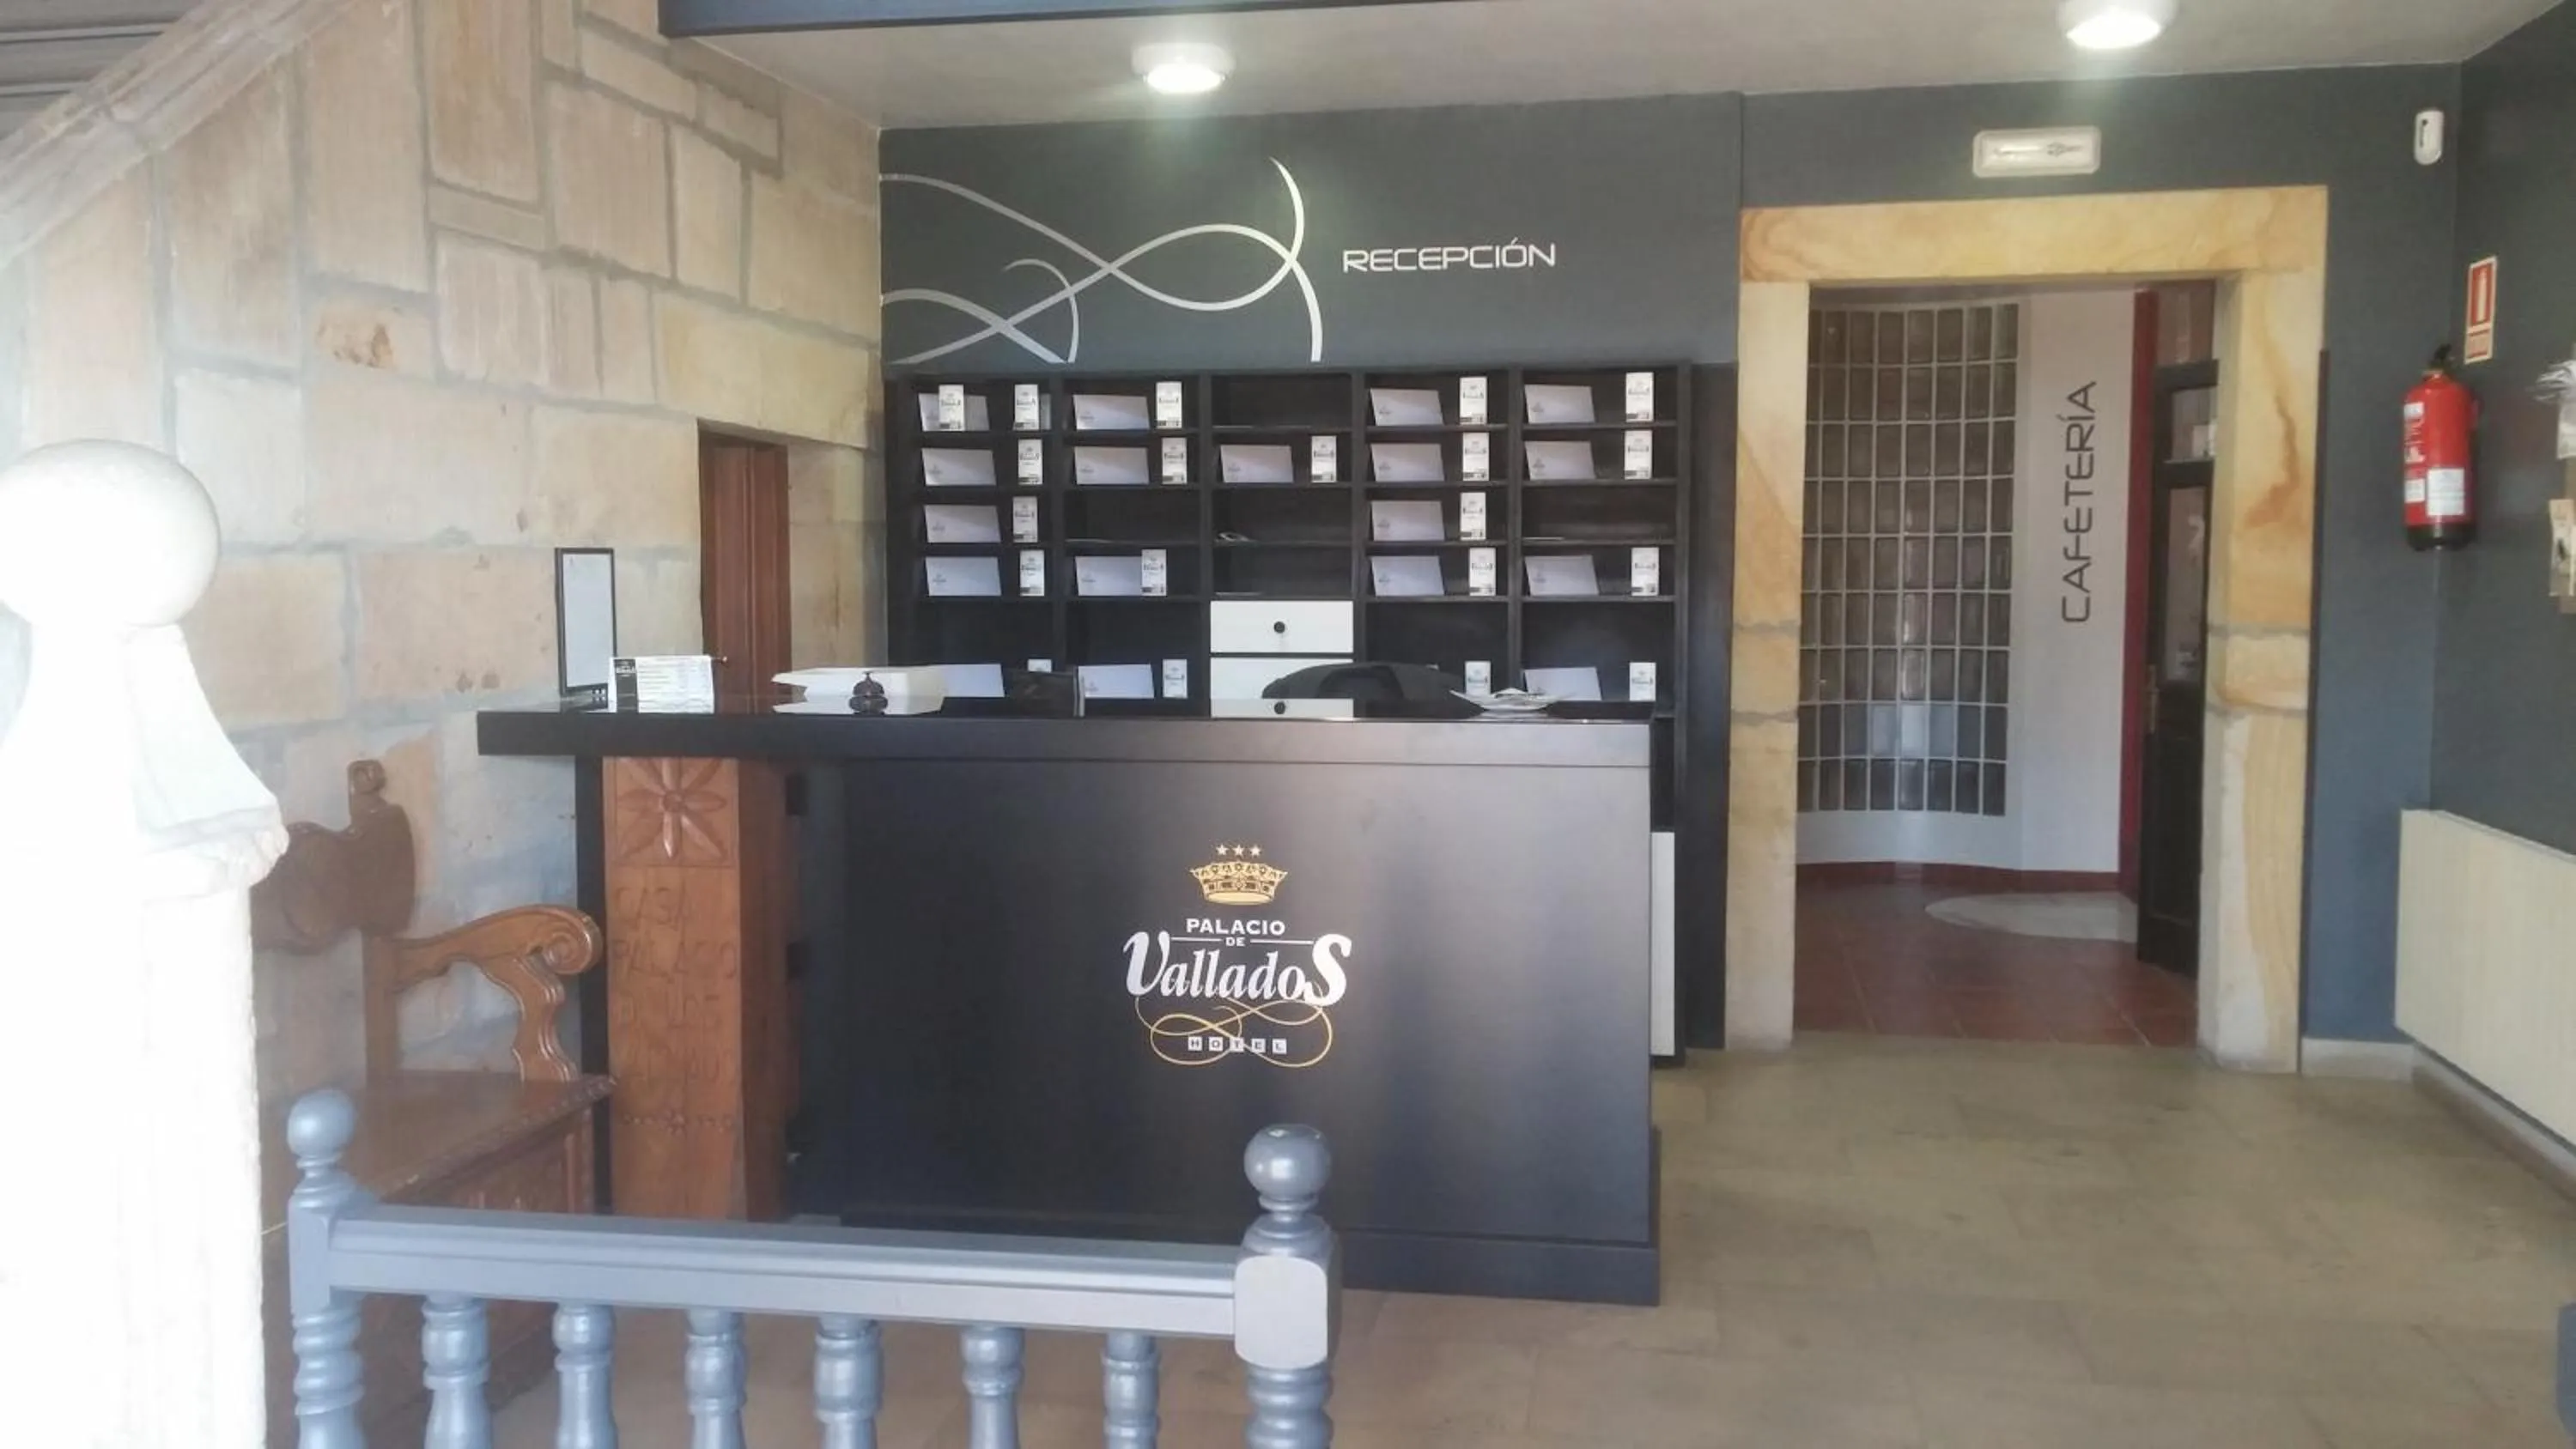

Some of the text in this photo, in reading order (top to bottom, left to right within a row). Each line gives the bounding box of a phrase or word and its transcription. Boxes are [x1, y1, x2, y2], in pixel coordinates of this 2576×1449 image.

[1343, 237, 1556, 273] RECEPCIÓN
[2057, 381, 2097, 622] CAFETERÍA
[1186, 918, 1285, 937] PALACIO
[1225, 937, 1245, 947] DE
[1188, 1036, 1287, 1054] HOTEL
